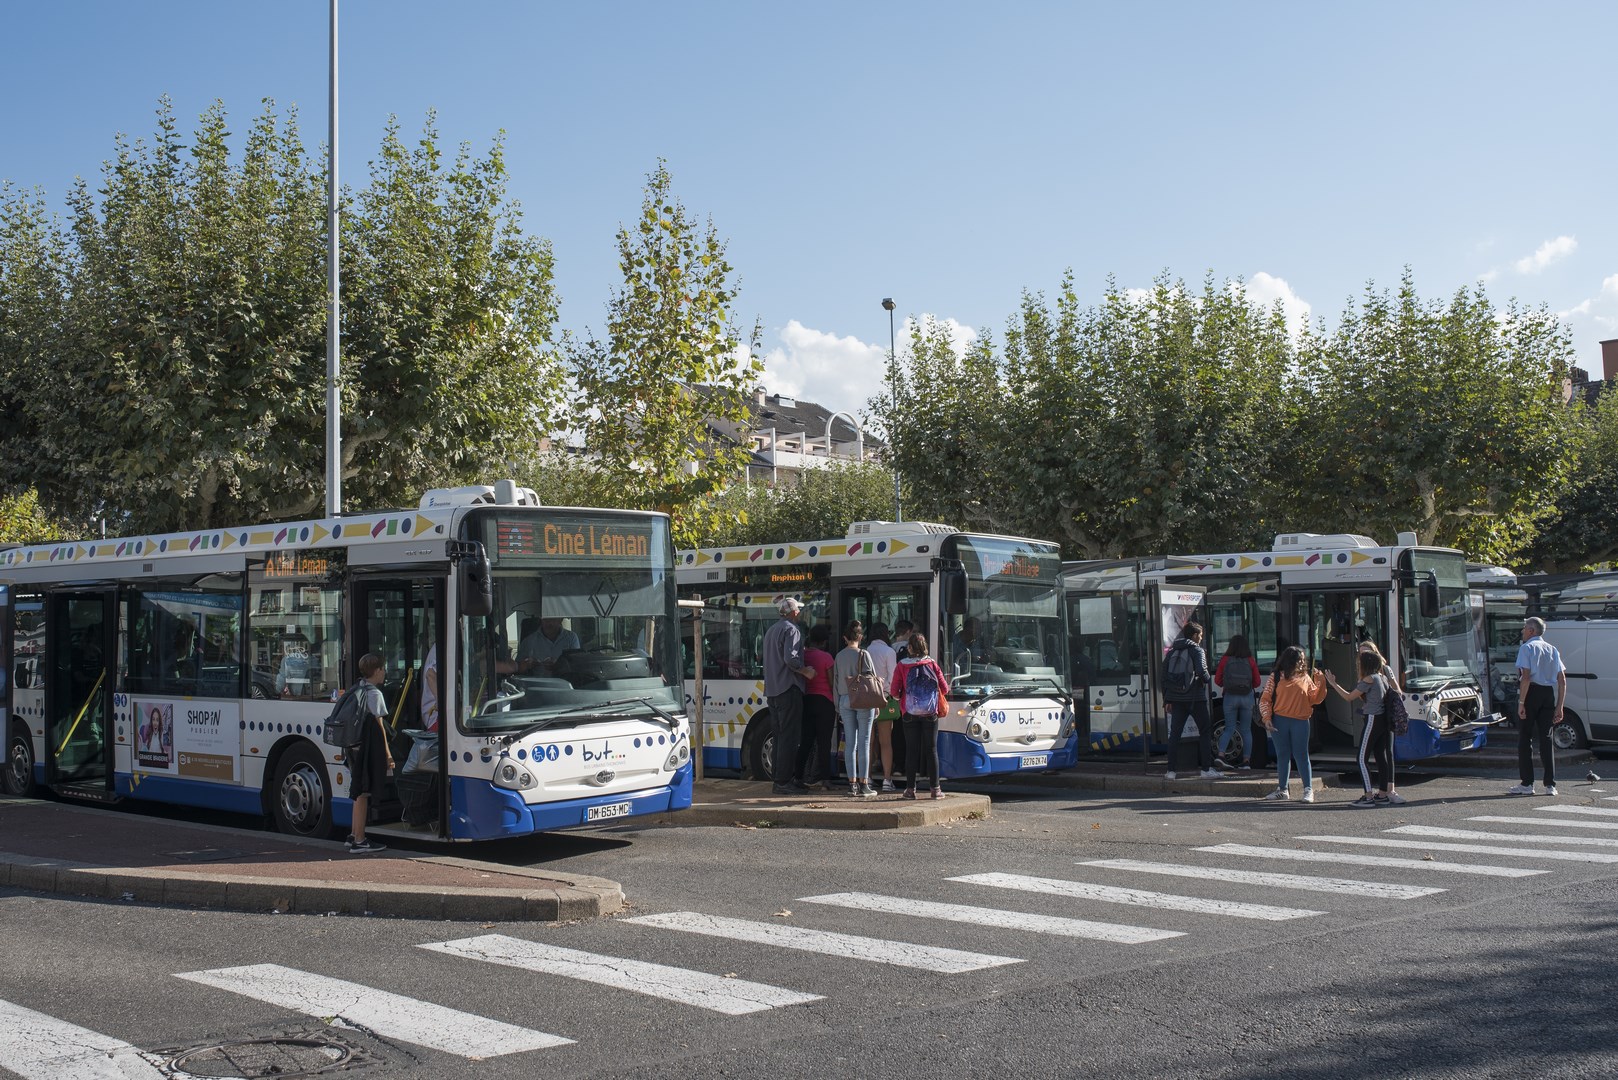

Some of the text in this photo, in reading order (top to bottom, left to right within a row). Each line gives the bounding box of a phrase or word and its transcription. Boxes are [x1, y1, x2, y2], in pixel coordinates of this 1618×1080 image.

[544, 523, 586, 555] Ciné
[590, 524, 647, 556] Léman
[771, 573, 805, 582] Amphion
[485, 736, 497, 745] 16
[588, 803, 629, 820] DM-653-MC
